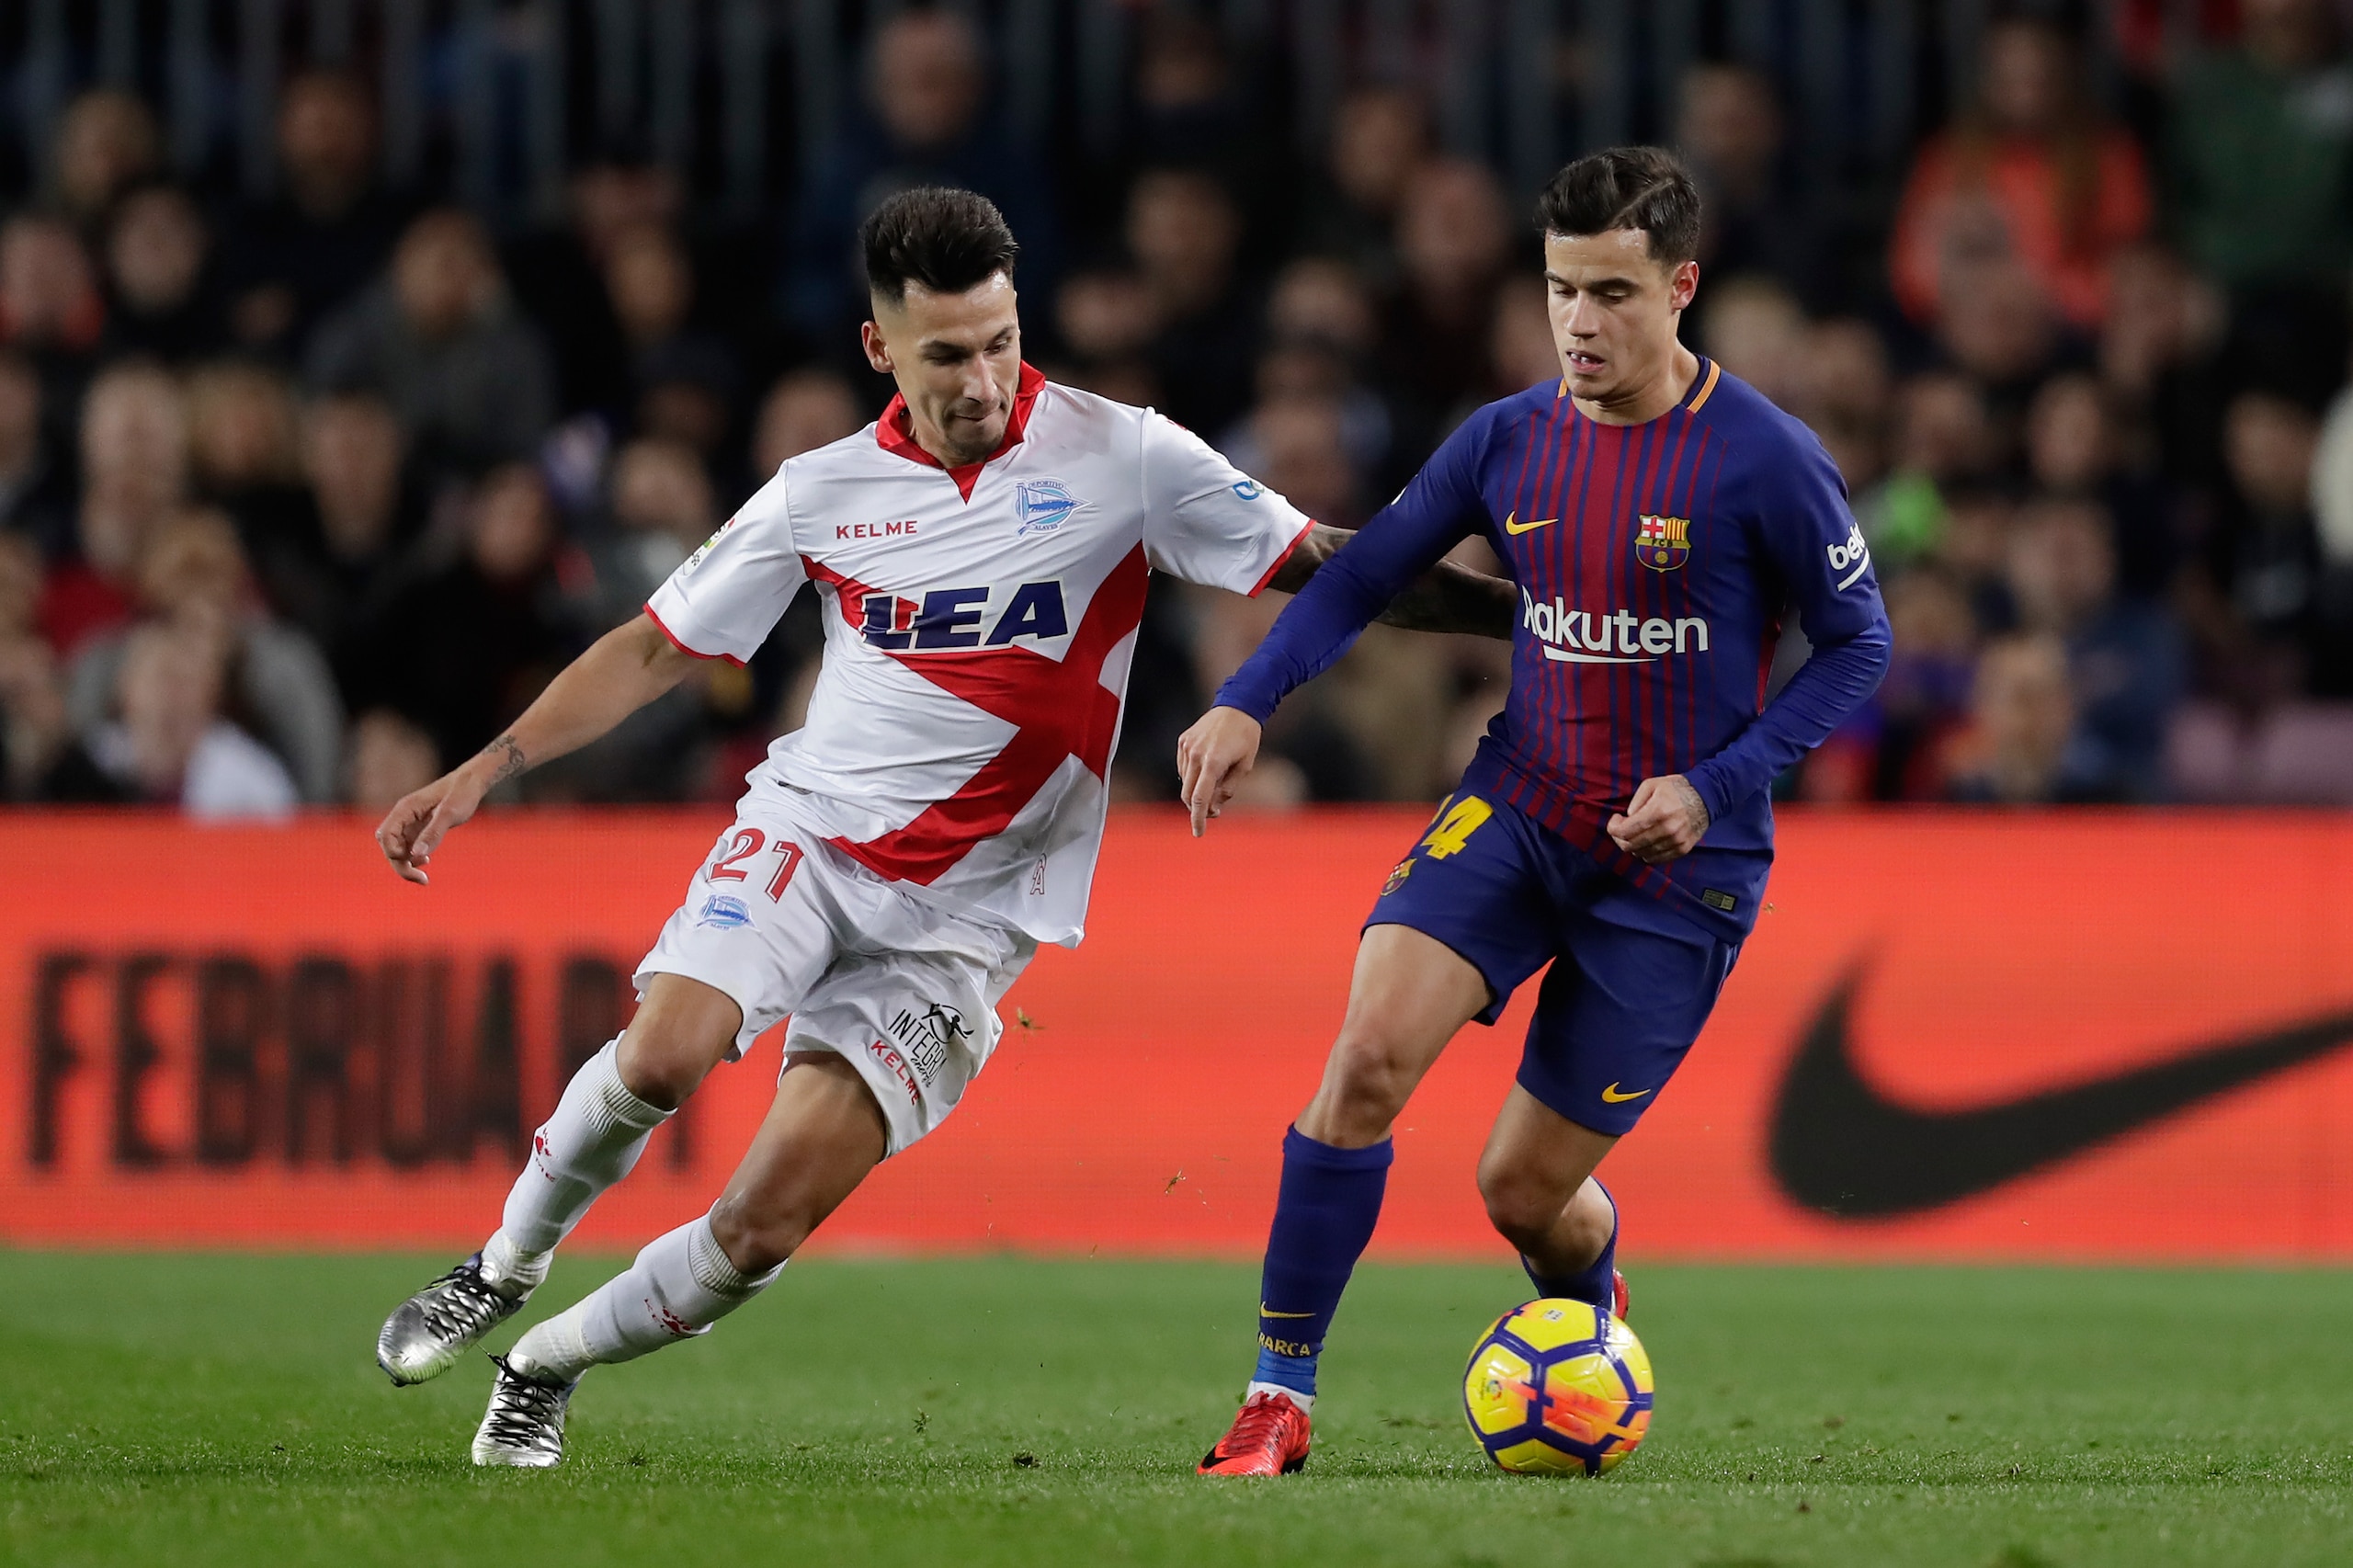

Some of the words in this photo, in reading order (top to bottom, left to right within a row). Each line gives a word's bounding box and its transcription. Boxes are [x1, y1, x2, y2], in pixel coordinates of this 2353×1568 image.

[835, 520, 918, 540] KELME
[1826, 522, 1866, 570] bek
[860, 579, 1070, 651] LEA
[1521, 584, 1710, 655] Rakuten
[705, 827, 804, 904] 21
[870, 1040, 921, 1107] KELME
